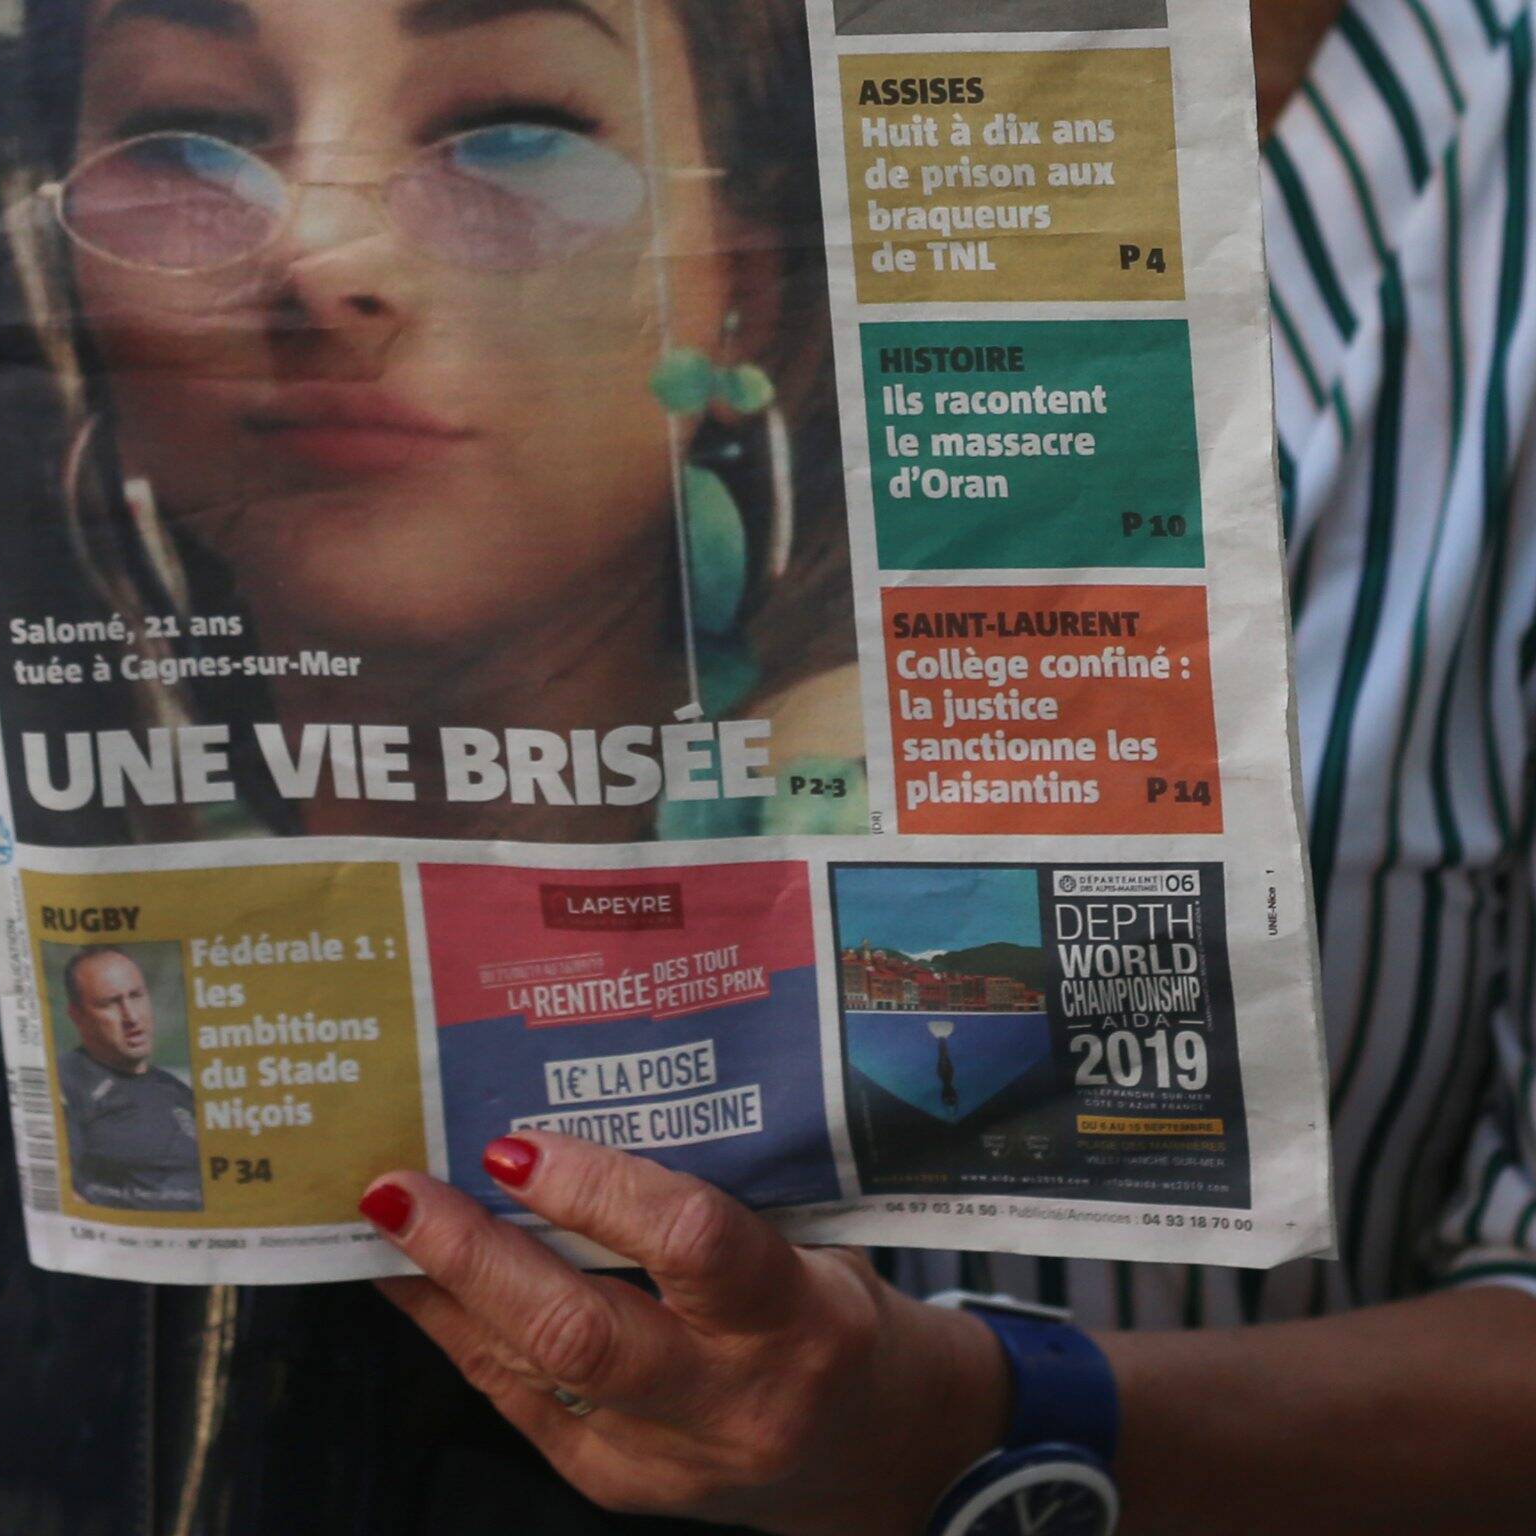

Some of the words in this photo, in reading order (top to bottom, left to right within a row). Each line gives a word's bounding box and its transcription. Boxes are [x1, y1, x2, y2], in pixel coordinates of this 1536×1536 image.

[858, 76, 985, 106] ASSISES
[862, 114, 940, 148] Huit
[950, 112, 972, 146] à
[982, 112, 1042, 146] dix
[1052, 117, 1116, 145] ans
[865, 157, 910, 191] de
[921, 155, 1036, 196] prison
[1047, 160, 1116, 187] aux
[867, 199, 1052, 236] braqueurs
[871, 240, 917, 274] de
[926, 239, 997, 272] TNL
[1119, 244, 1141, 271] P
[1145, 247, 1167, 274] 4
[880, 345, 1025, 374] HISTOIRE
[882, 383, 924, 416] Ils
[935, 383, 1108, 415] racontent
[885, 425, 920, 458] le
[931, 431, 1096, 458] massacre
[889, 466, 1010, 500] d'Oran
[1122, 511, 1143, 538] P
[1149, 514, 1186, 539] 10
[9, 612, 135, 645] Salomé,
[144, 615, 181, 639] 21
[189, 614, 243, 638] ans
[892, 610, 1141, 639] SAINT-LAURENT
[14, 657, 84, 685] tuée
[92, 656, 112, 683] à
[120, 649, 362, 685] Cagnes-sur-Mer
[896, 646, 1029, 687] Collège
[1039, 645, 1172, 680] confiné
[898, 689, 933, 722] la
[943, 687, 1059, 728] justice
[20, 724, 237, 812] UNE
[252, 722, 417, 802] VIE
[439, 702, 777, 807] BRISÉE
[902, 728, 1096, 763] sanctionne
[1106, 728, 1158, 762] les
[789, 775, 806, 796] P
[809, 776, 847, 798] 2-3
[905, 771, 1100, 810] plaisantins
[1147, 776, 1168, 804] P
[1173, 780, 1212, 806] 14
[871, 810, 884, 835] (DR)
[1165, 874, 1195, 893] 06
[40, 905, 142, 933] RUGBY
[566, 894, 673, 917] LAPEYRE
[1054, 903, 1195, 942] DEPTH
[1266, 887, 1278, 937] UNE-Nice
[191, 931, 344, 968] Fédérale
[355, 935, 375, 961] 1
[652, 957, 690, 984] DES
[693, 944, 740, 974] TOUT
[1057, 942, 1199, 979] WORLD
[193, 976, 246, 1009] les
[506, 987, 533, 1011] LA
[532, 967, 653, 1018] RENTRÉE
[655, 976, 717, 1010] PETITS
[722, 966, 766, 996] PRIX
[1060, 975, 1201, 1018] CHAMPIONSHIP
[197, 1013, 379, 1050] ambitions
[1101, 1012, 1172, 1030] AIDA
[200, 1058, 247, 1091] du
[257, 1053, 361, 1088] Stade
[597, 1063, 632, 1096] LA
[638, 1047, 711, 1092] POSE
[1069, 1029, 1209, 1091] 2019
[203, 1096, 313, 1137] Niçois
[649, 1090, 757, 1143] CUISINE
[1080, 1120, 1097, 1131] DU
[1109, 1121, 1126, 1132] AU
[1144, 1122, 1214, 1133] SEPTEMBRE
[209, 1156, 229, 1182] P
[235, 1158, 273, 1184] 34
[885, 1201, 905, 1213] 04
[1142, 1212, 1161, 1227] 04
[1166, 1214, 1185, 1228] 93
[1189, 1215, 1208, 1230] 18
[1211, 1216, 1230, 1231] 70
[1234, 1217, 1253, 1233] 00
